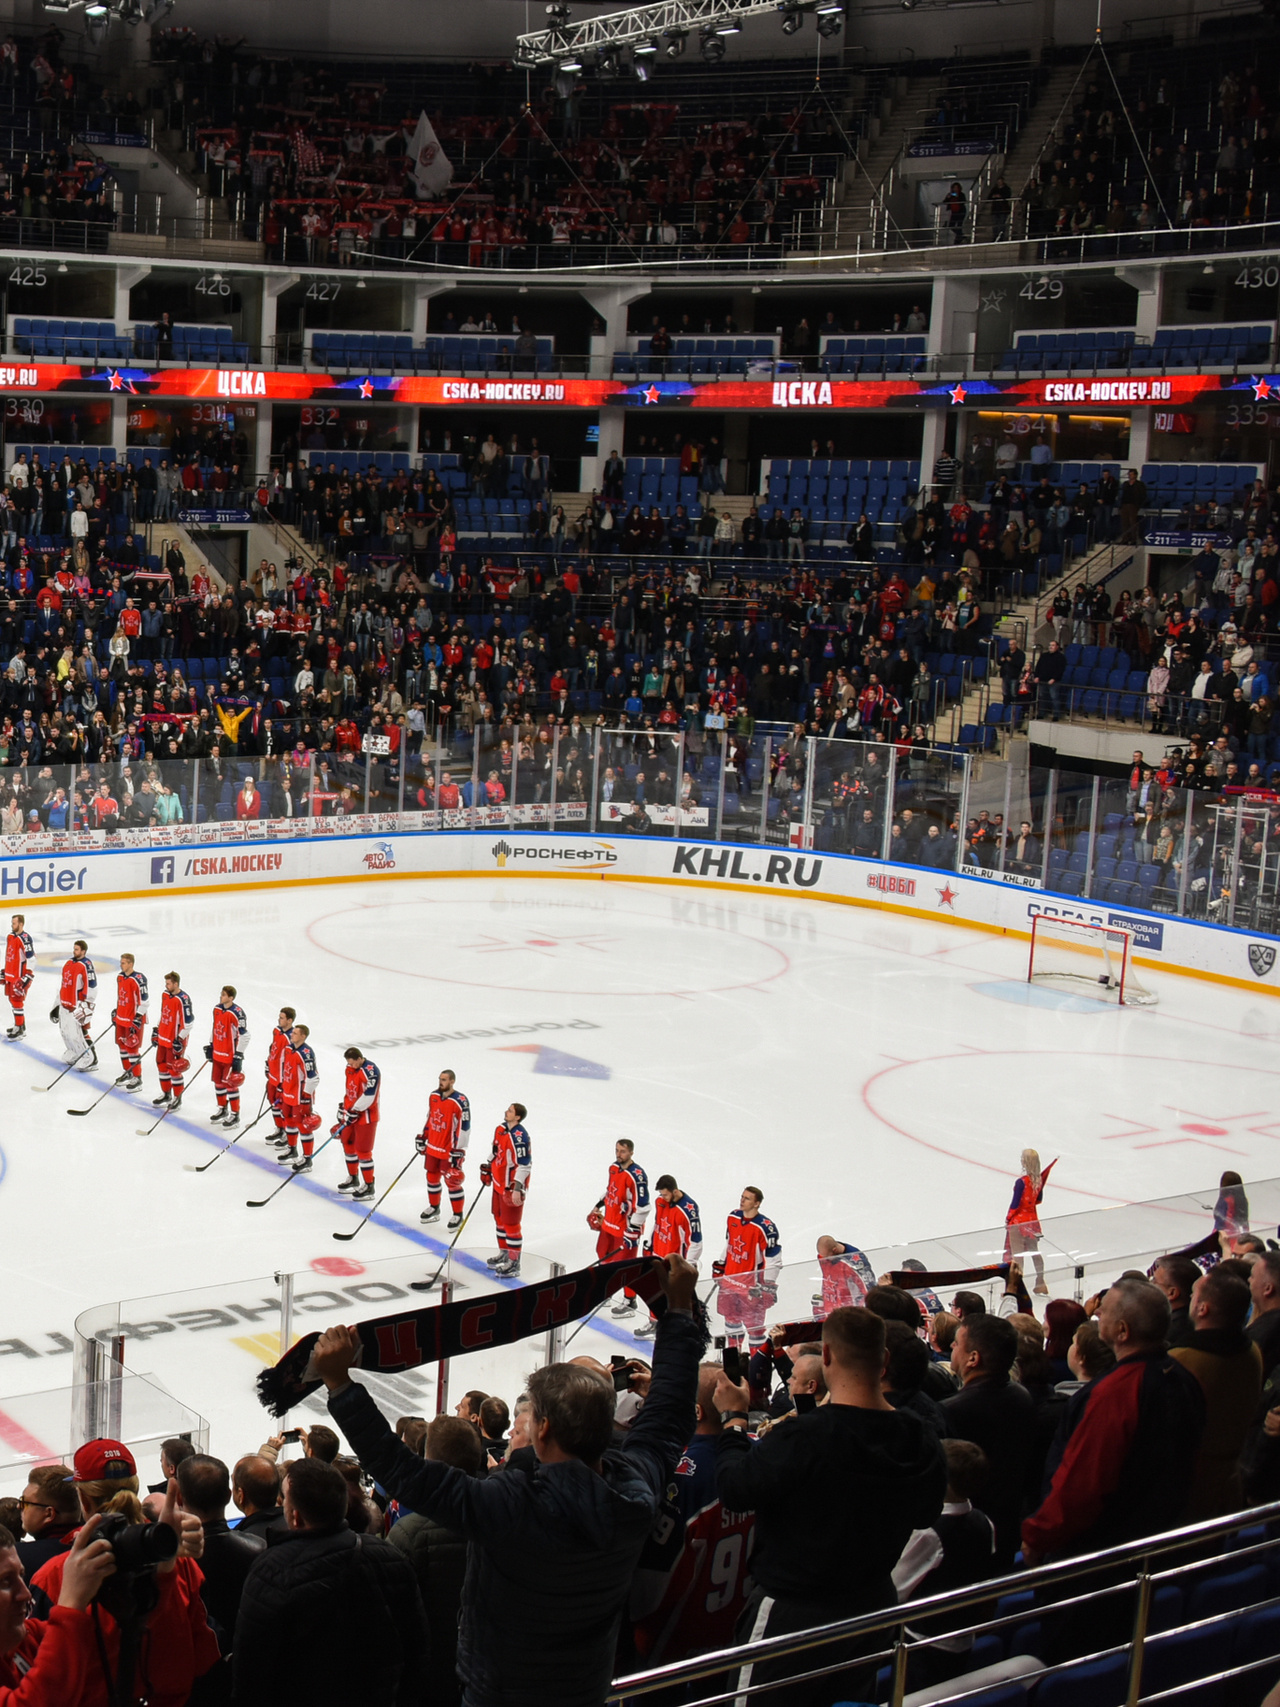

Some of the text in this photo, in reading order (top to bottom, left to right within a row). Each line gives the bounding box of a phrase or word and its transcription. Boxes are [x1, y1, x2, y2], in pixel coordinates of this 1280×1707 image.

[9, 267, 47, 287] 425
[195, 276, 231, 296] 426
[1235, 267, 1279, 289] 430
[306, 283, 342, 301] 427
[1019, 279, 1064, 300] 429
[217, 371, 266, 396] ЦСКА
[443, 382, 565, 401] CSKA-HOCKEY.RU
[1045, 382, 1171, 402] CSKA-HOCKEY.RU
[772, 381, 833, 407] ЦСКА
[6, 398, 45, 418] 330
[301, 407, 337, 426] 332
[1226, 404, 1269, 425] 335
[216, 514, 230, 522] 211
[1154, 536, 1170, 545] 211
[1191, 537, 1207, 546] 212
[362, 852, 385, 863] АВТО
[513, 846, 618, 863] РОСНЕФТЬ
[184, 852, 282, 877] /CSKA.HOCKEY
[368, 860, 396, 870] РАДИО
[672, 846, 823, 888] KHL.RU
[961, 864, 994, 879] KHL.RU
[1, 862, 88, 896] Haier
[867, 872, 918, 897] #ЦВБП
[1002, 873, 1036, 888] KHL.RU
[1111, 919, 1160, 936] СТРАХОВАЯ
[517, 1147, 526, 1158] 21
[639, 1186, 645, 1198] 9
[691, 1220, 701, 1233] 71
